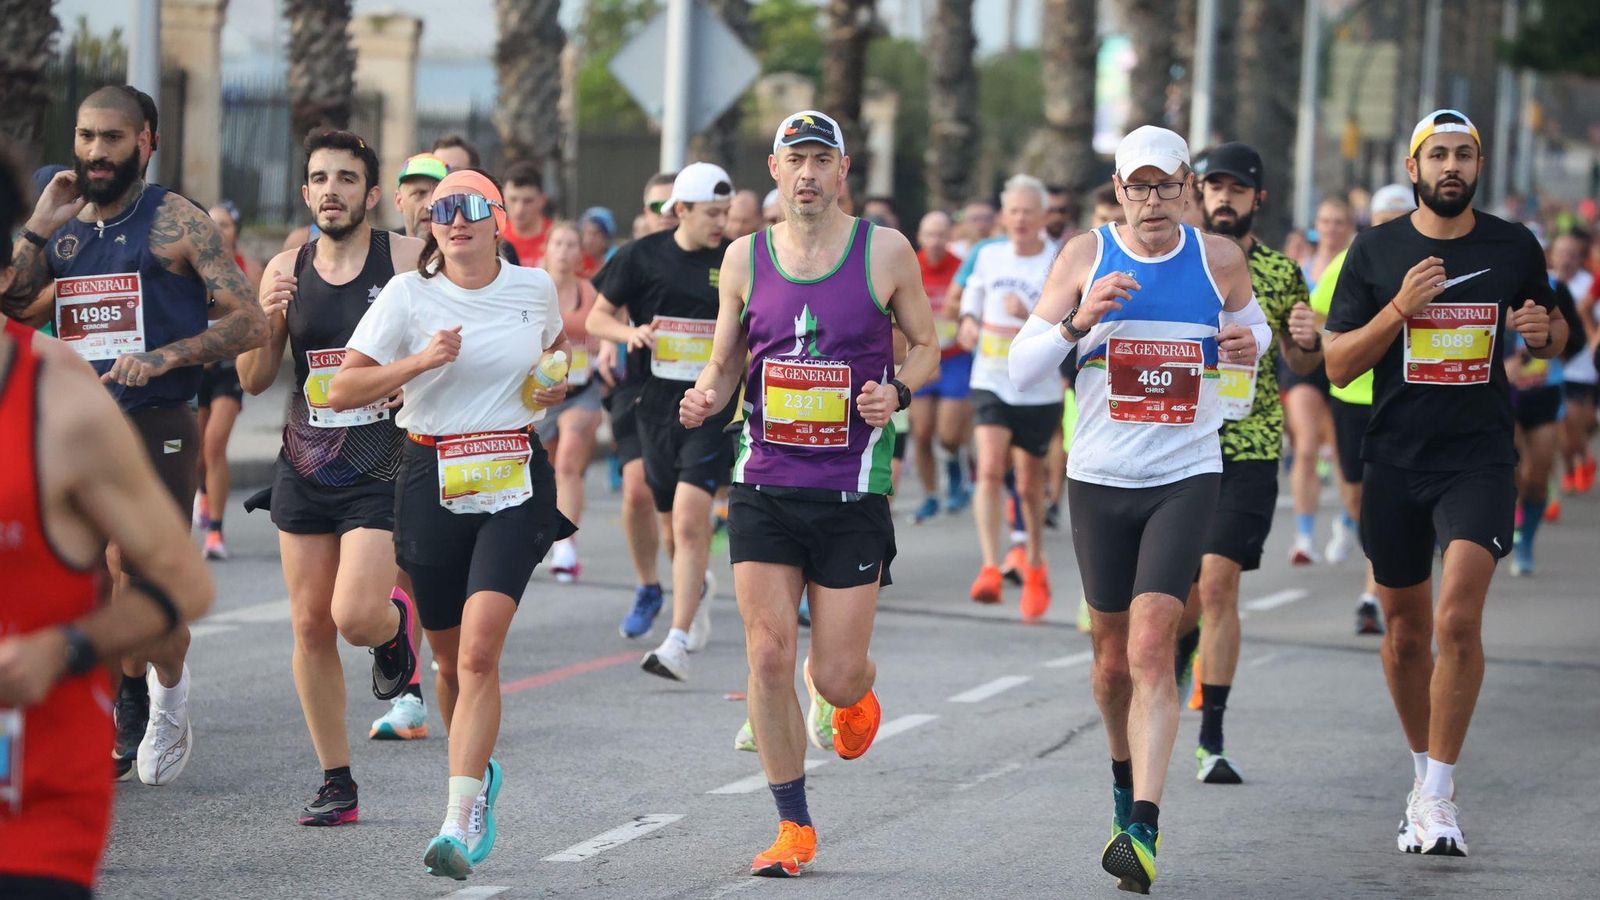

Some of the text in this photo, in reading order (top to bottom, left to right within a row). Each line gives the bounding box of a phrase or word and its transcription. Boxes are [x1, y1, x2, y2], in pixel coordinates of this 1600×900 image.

[73, 278, 133, 294] GENERALI
[71, 305, 122, 323] 14985
[1432, 308, 1491, 320] GENERALI
[1431, 333, 1474, 348] 5089
[1134, 343, 1196, 357] GENERALI
[784, 368, 844, 382] GENERALI
[1137, 370, 1172, 386] 460
[784, 393, 824, 409] 2321
[464, 439, 523, 454] GENERALI
[461, 464, 512, 483] 16143
